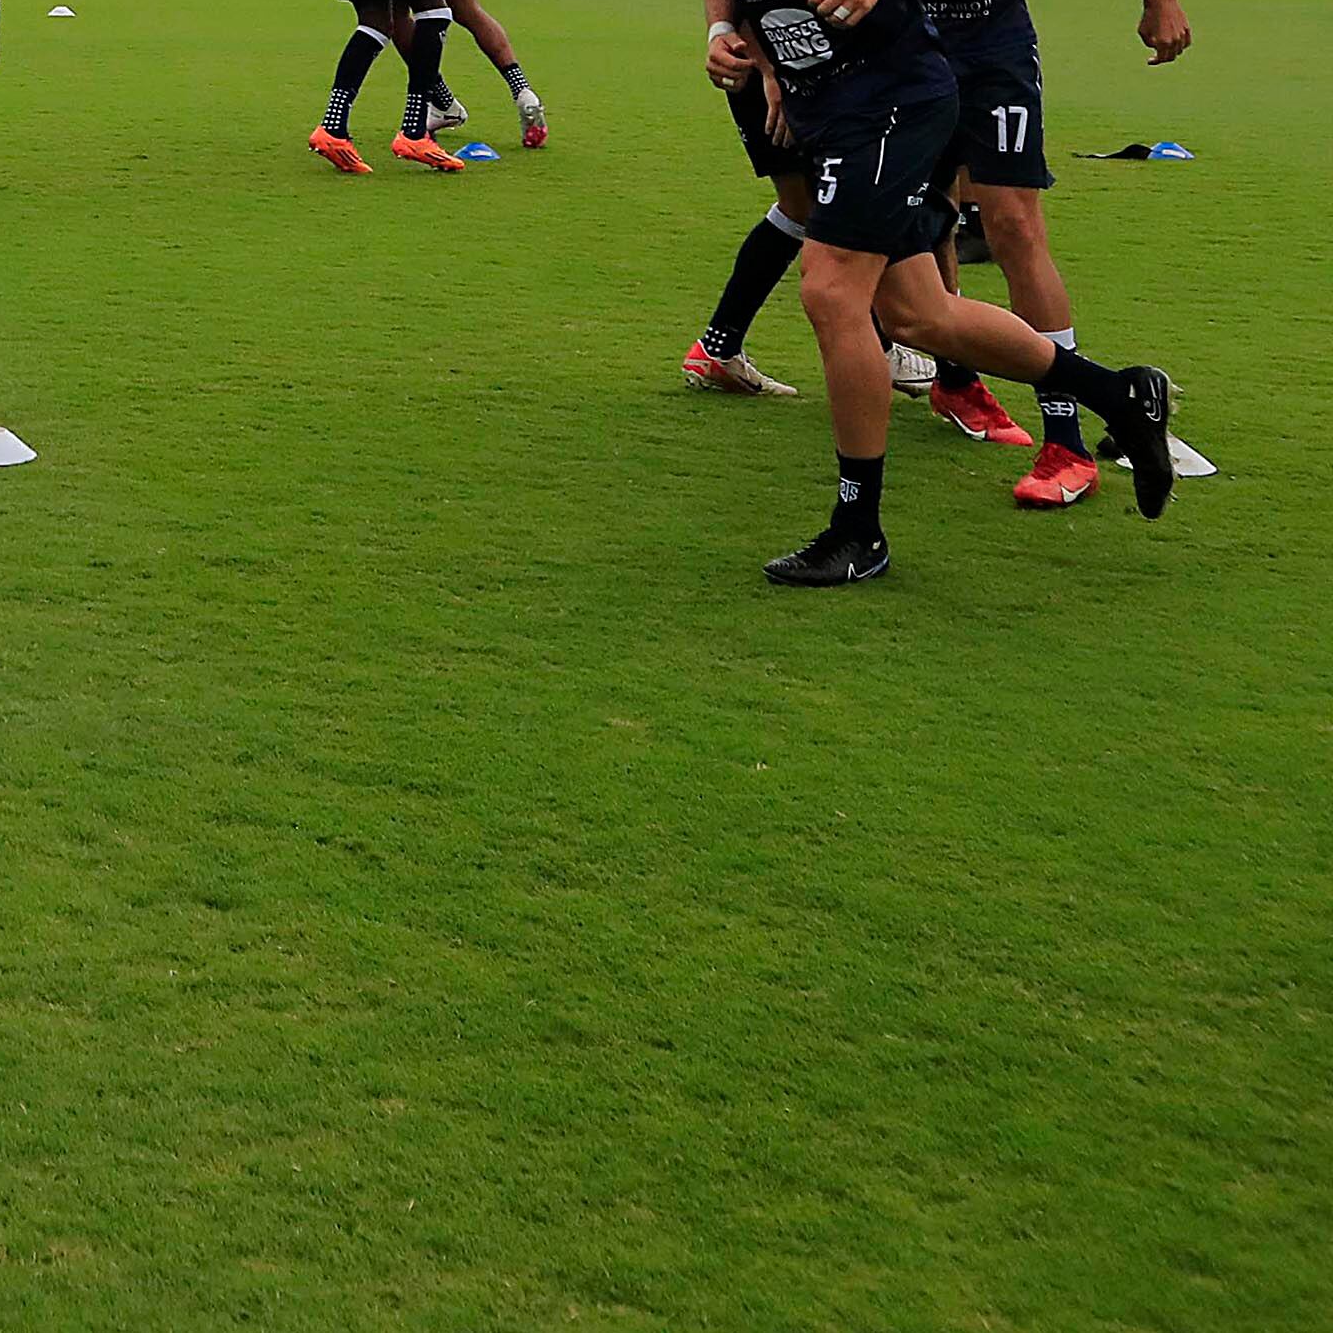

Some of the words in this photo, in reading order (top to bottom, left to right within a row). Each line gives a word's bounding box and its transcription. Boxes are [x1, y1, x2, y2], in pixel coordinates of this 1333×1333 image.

[764, 20, 822, 42] BURGER
[773, 33, 830, 61] KING
[990, 105, 1029, 153] 17
[817, 157, 844, 205] 5
